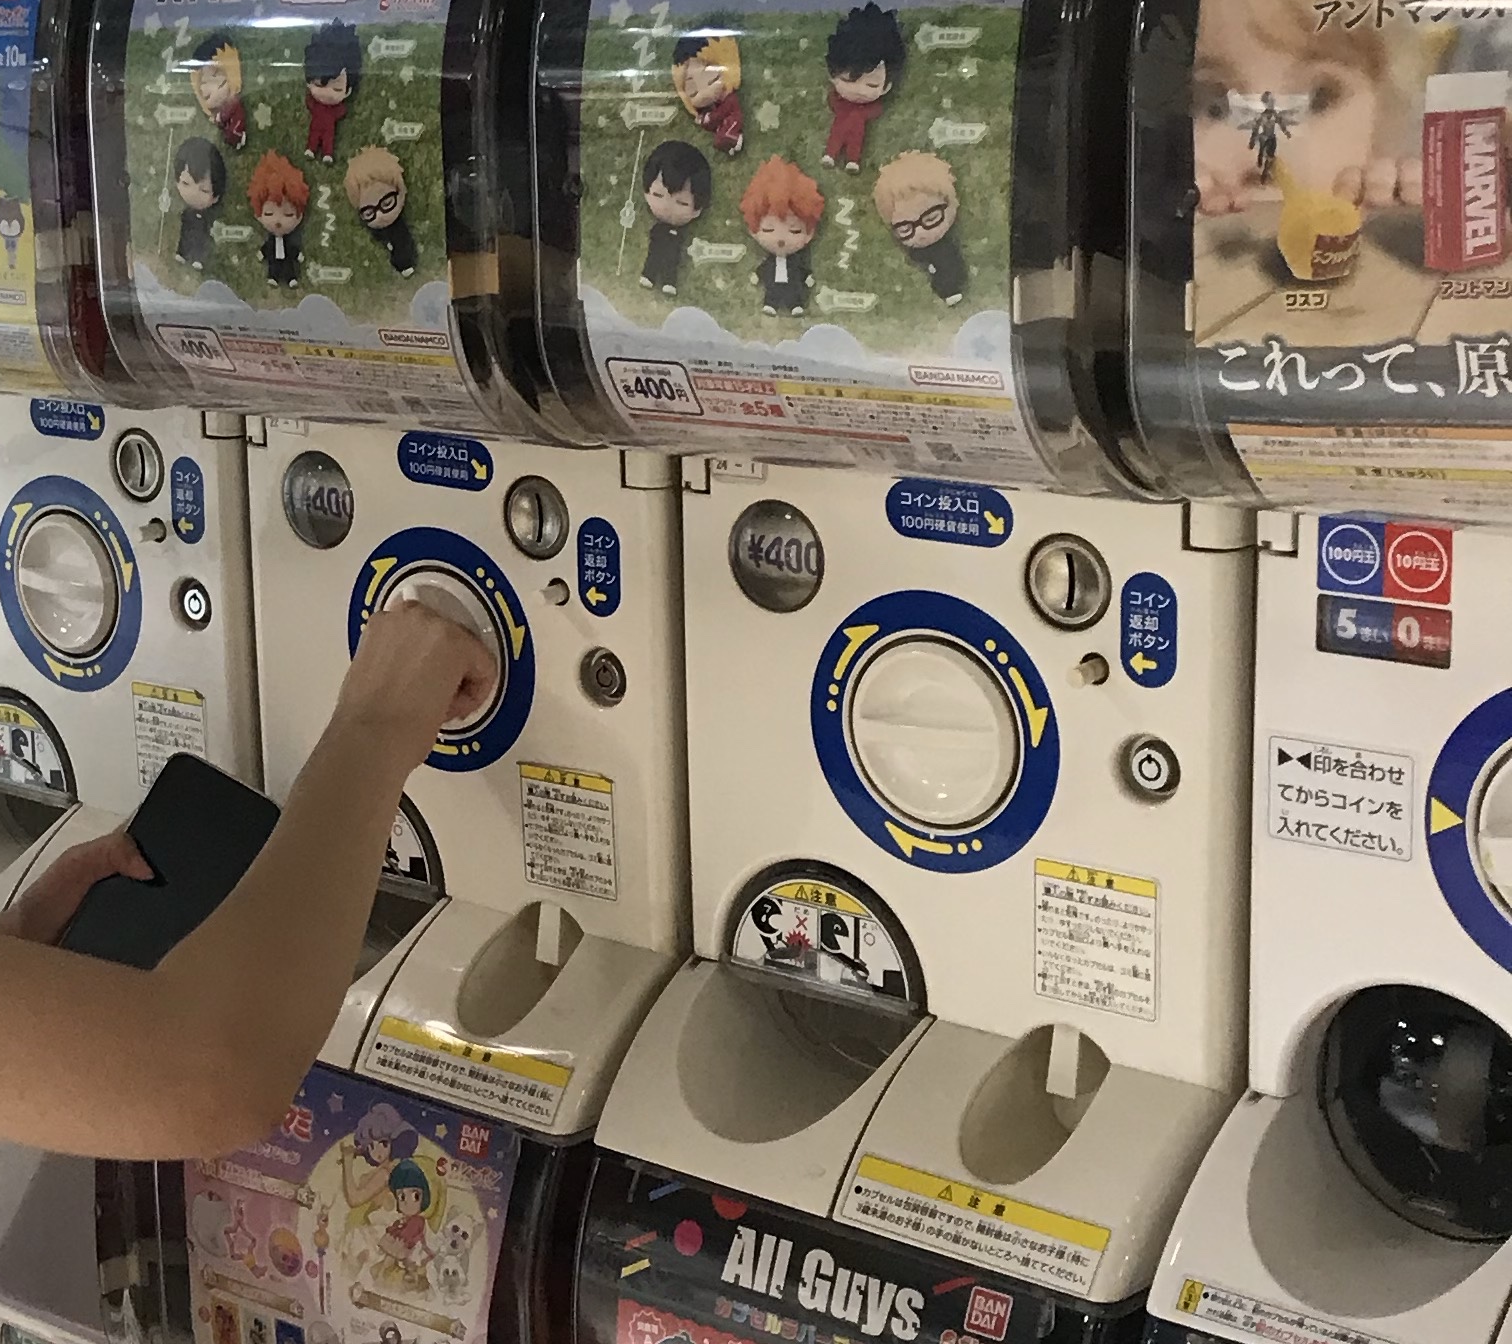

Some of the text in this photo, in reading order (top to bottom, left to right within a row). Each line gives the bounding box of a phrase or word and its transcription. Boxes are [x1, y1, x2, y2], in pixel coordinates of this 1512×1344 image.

[1463, 121, 1497, 256] MARVEL
[899, 491, 980, 515] コイン投入口
[899, 514, 980, 537] 100円硬貨使用
[583, 533, 615, 549] コイン
[747, 532, 820, 577] ¥400
[583, 569, 616, 585] ボタン
[1127, 589, 1172, 610] コイン
[1127, 612, 1160, 633] 返却
[1127, 632, 1172, 652] ボタン
[1313, 754, 1405, 786] 印を合わせ
[1277, 783, 1403, 821] てからコインを
[1276, 815, 1404, 856] 入れてください。
[720, 1224, 925, 1341] All Guys
[974, 1295, 1009, 1318] BAN
[970, 1312, 1000, 1331] DAI
